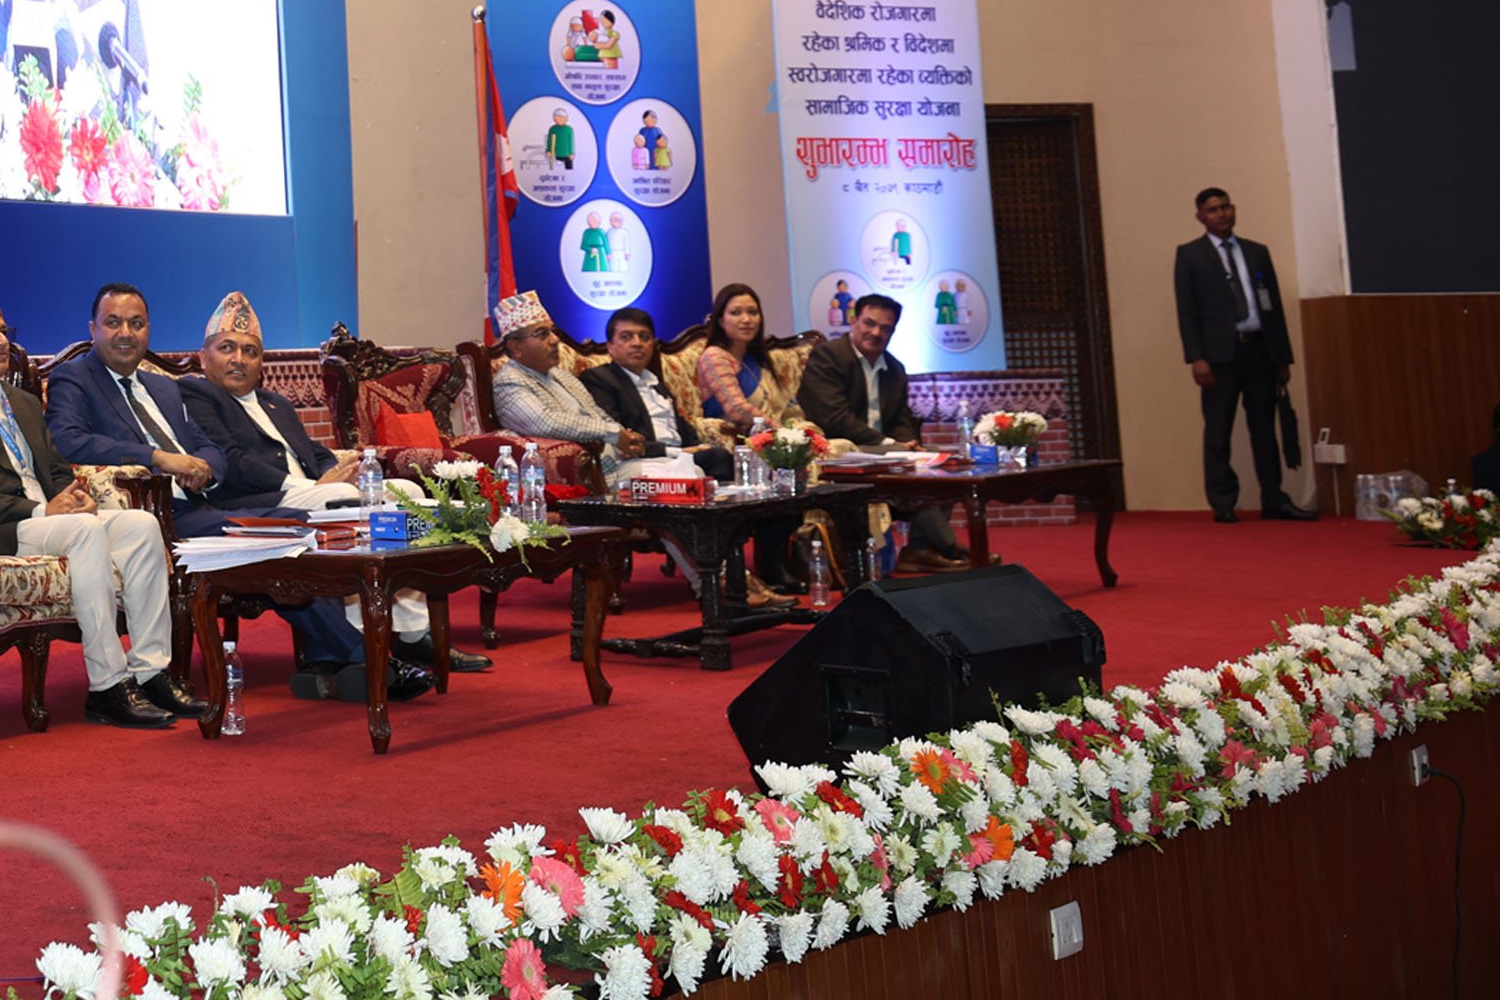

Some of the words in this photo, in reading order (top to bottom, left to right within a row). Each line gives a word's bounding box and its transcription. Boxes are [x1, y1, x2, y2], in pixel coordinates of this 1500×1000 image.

[816, 0, 865, 21] वैदेशिक
[870, 1, 936, 22] रोजगारमा
[801, 31, 840, 52] रहेका
[844, 31, 886, 53] श्रमिक
[891, 37, 900, 54] र
[904, 32, 955, 54] विदेशमा
[788, 63, 873, 84] स्वरोजगारमा
[877, 64, 914, 86] रहेका
[918, 65, 973, 86] व्यक्तिको
[805, 95, 869, 116] सामाजिक
[874, 100, 913, 120] सुरक्षा
[917, 97, 961, 117] योजना
[796, 136, 890, 180] शुभारम्भ
[897, 132, 977, 169] समारोह
[632, 481, 687, 494] PREMIUM
